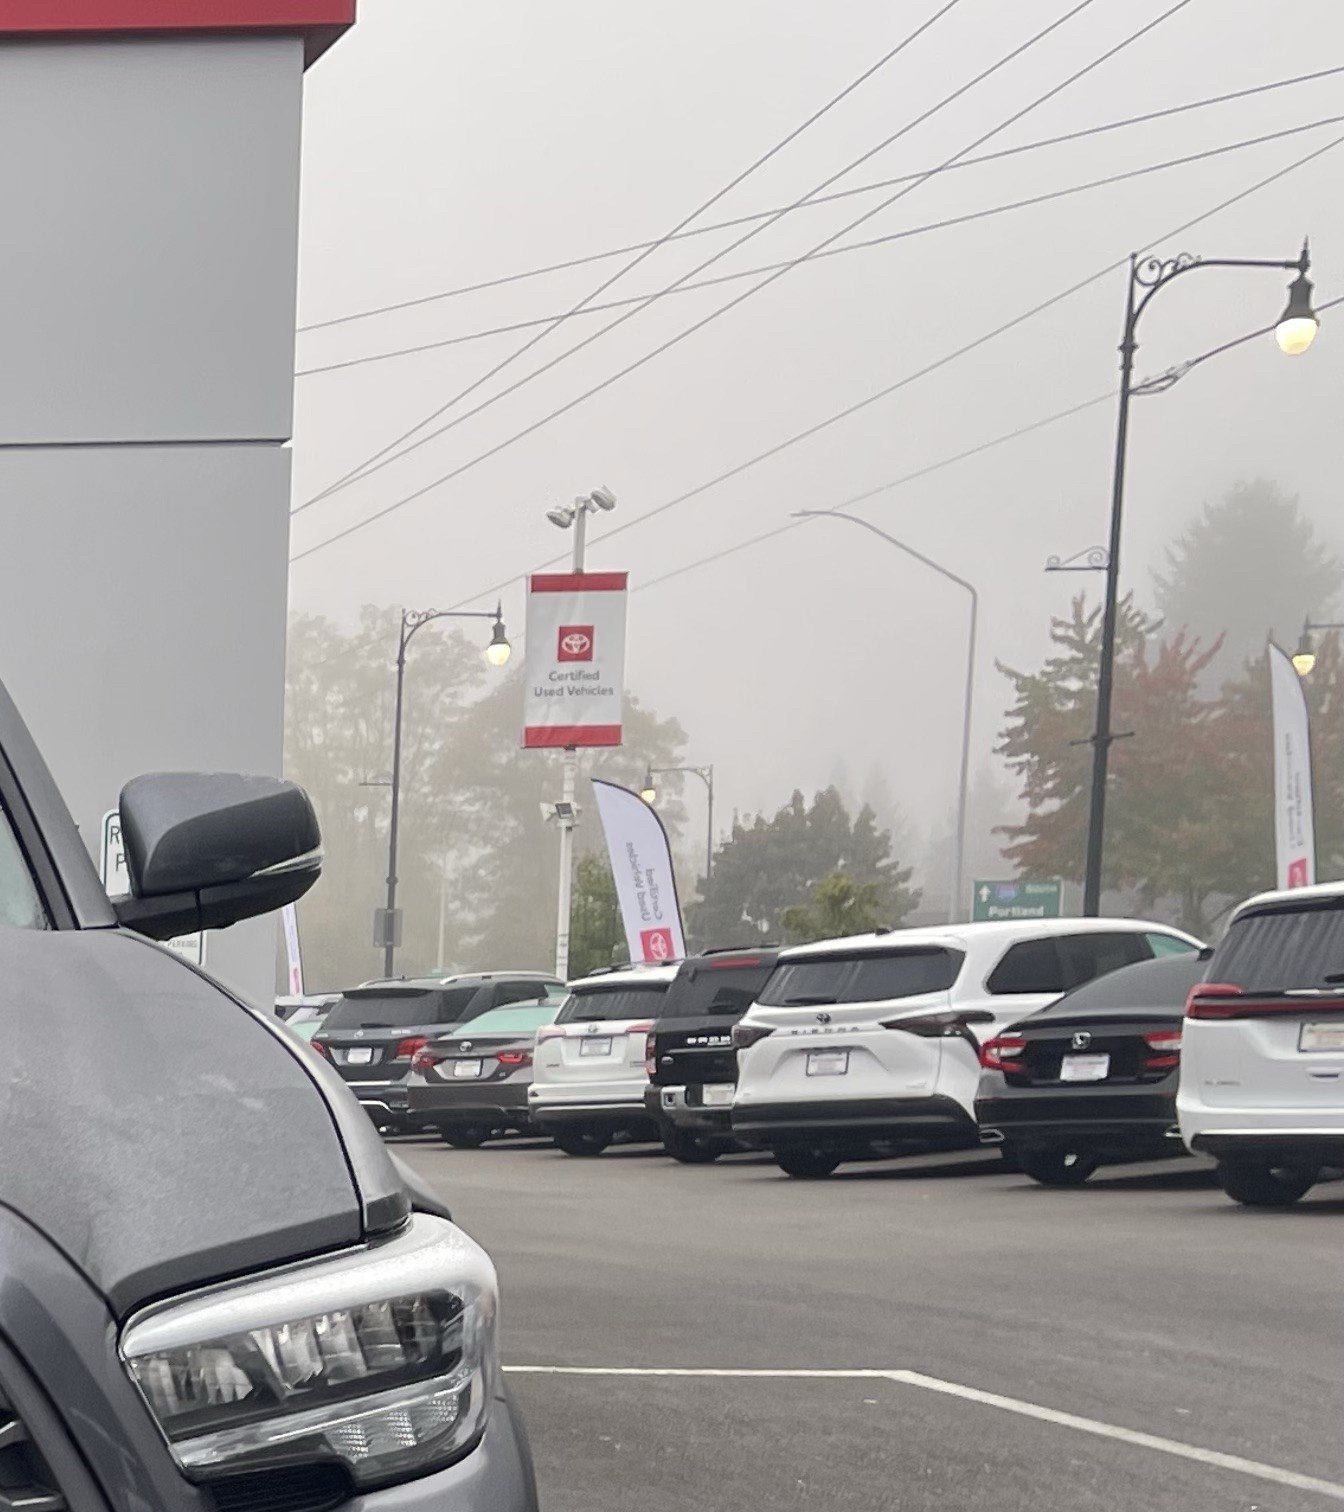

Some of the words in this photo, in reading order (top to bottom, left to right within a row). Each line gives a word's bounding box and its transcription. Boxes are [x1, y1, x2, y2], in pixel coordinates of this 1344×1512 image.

[548, 670, 601, 681] Certified
[534, 686, 564, 697] Used
[567, 685, 614, 696] Vehicles
